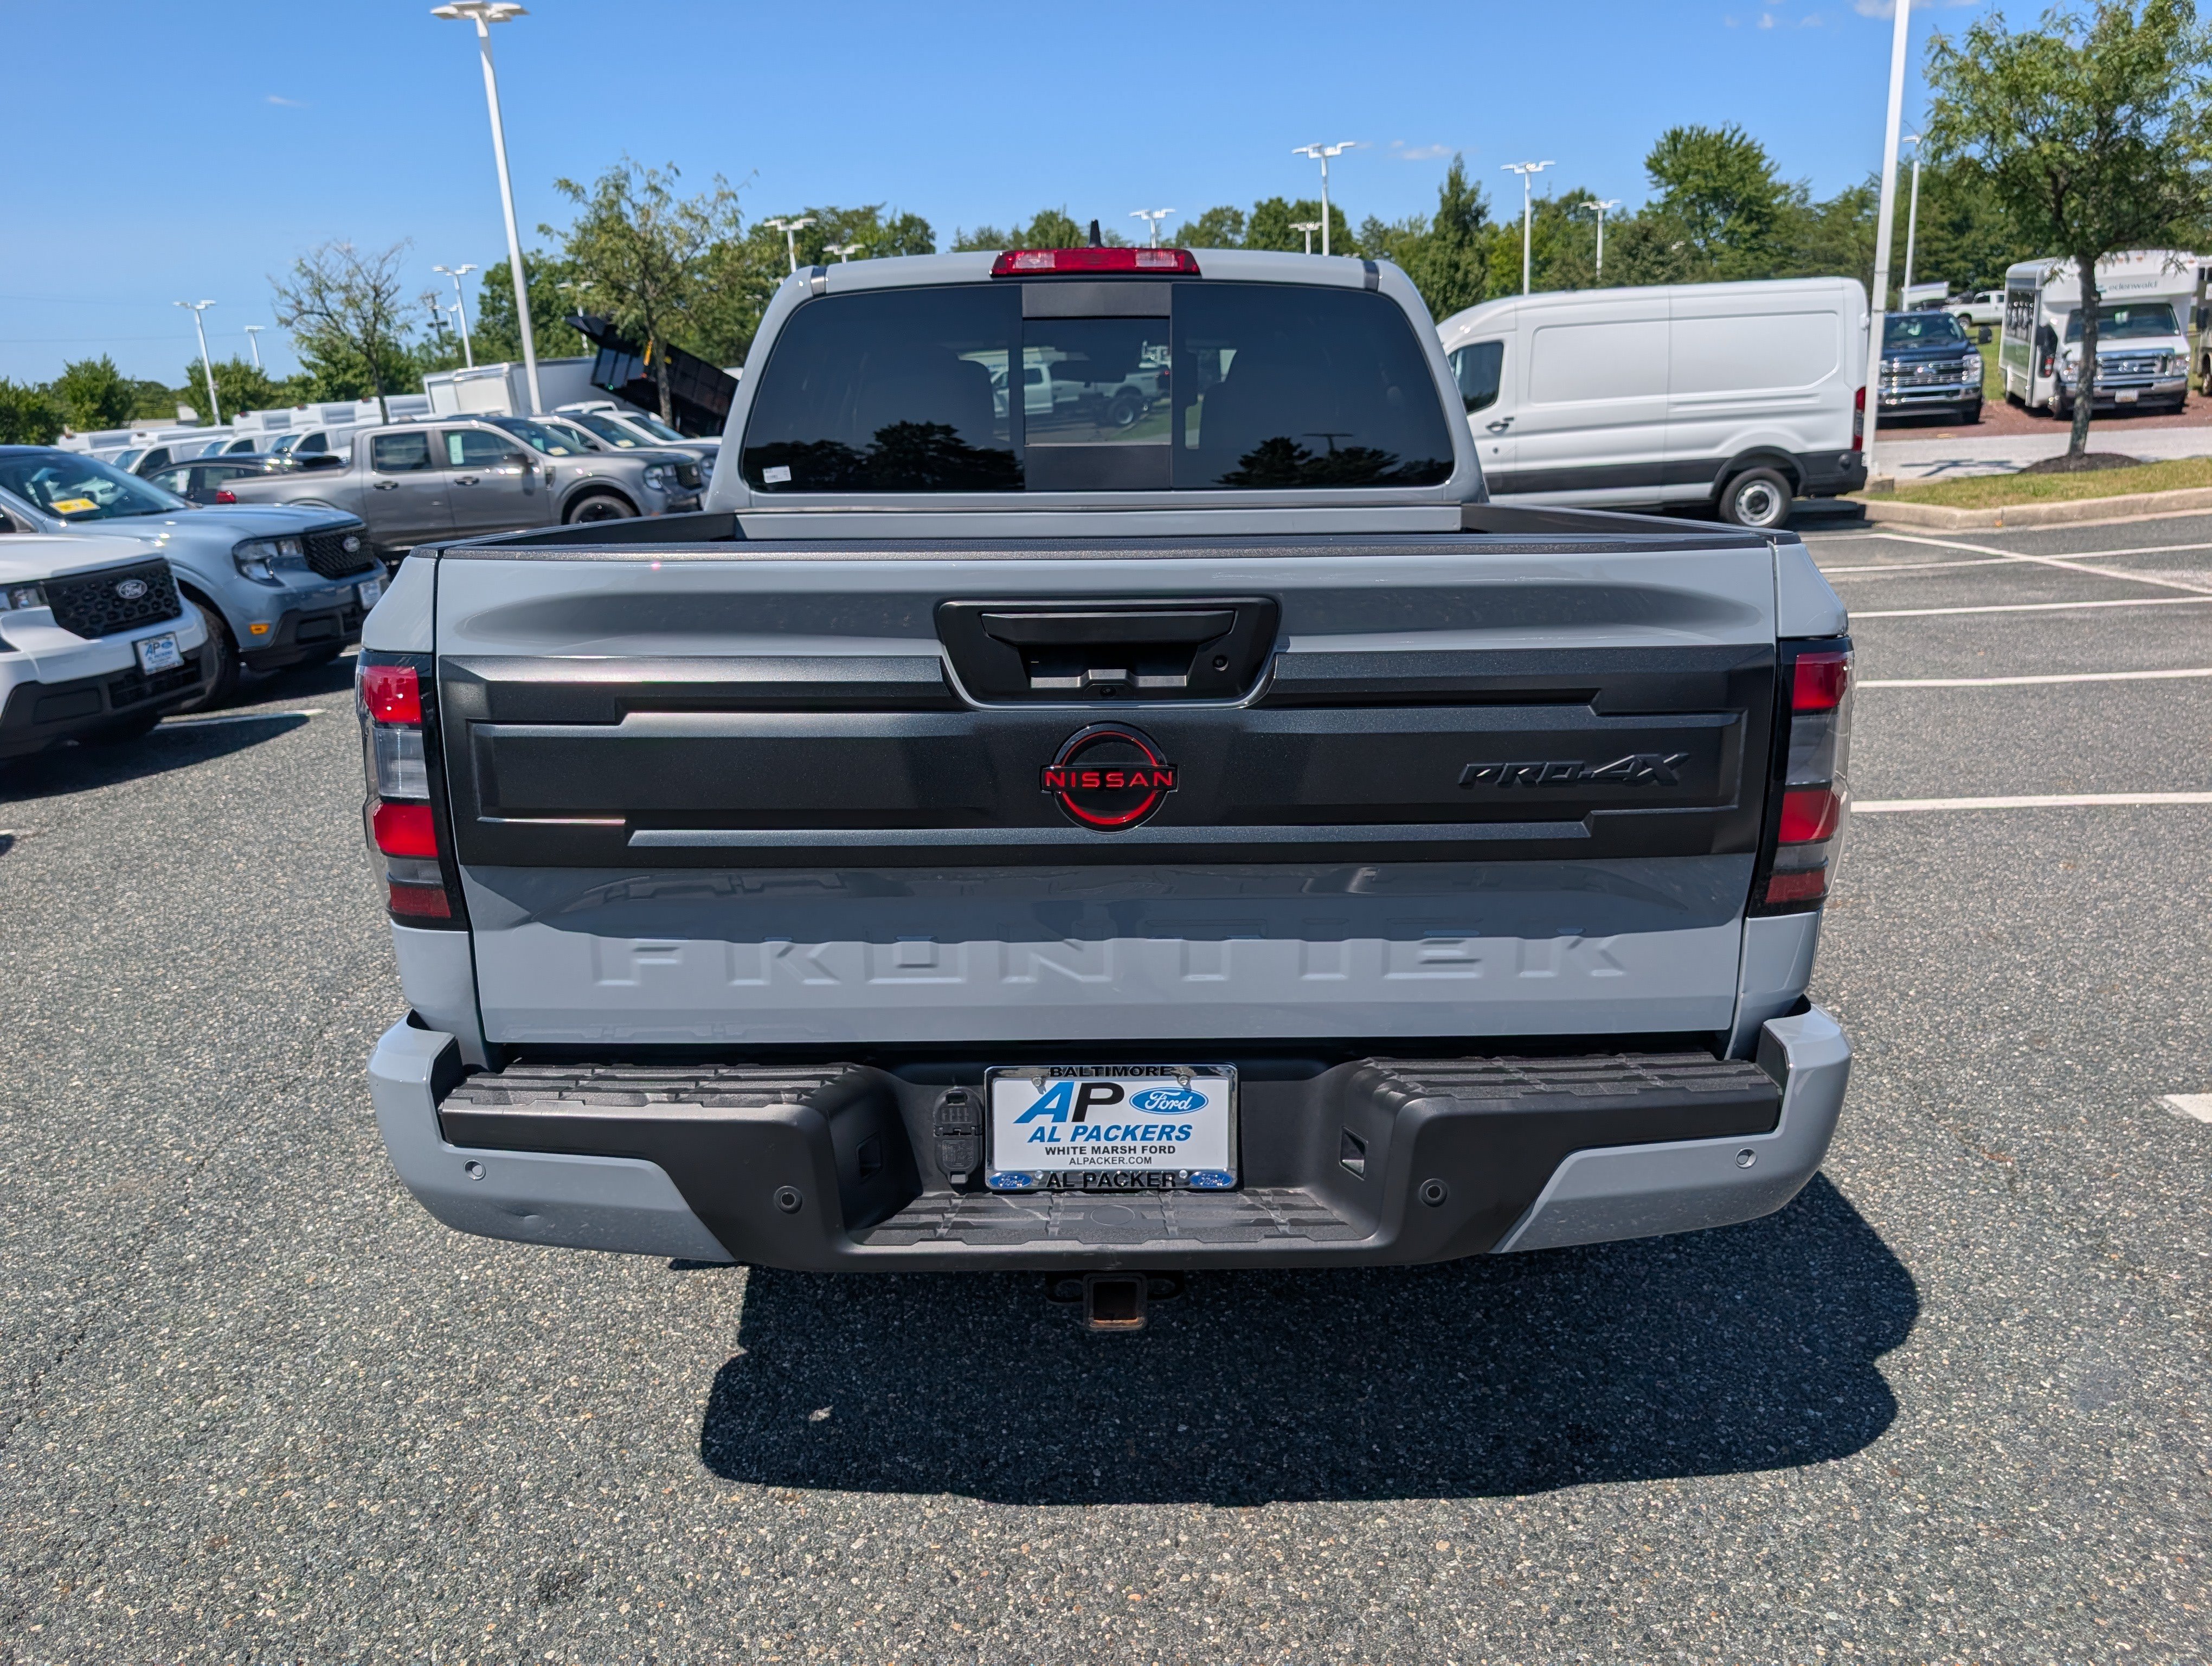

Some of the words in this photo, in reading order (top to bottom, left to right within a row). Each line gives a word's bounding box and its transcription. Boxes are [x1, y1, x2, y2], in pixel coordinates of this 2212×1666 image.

[2108, 280, 2158, 291] edenwald
[145, 642, 160, 657] AP
[1458, 753, 1690, 787] PRO-4X
[1045, 771, 1173, 787] NISSAN
[591, 930, 1626, 986] FRONTIER
[1050, 1066, 1173, 1077] BALTIMORE
[1013, 1081, 1125, 1124] AP
[1144, 1091, 1193, 1110] Ford
[1027, 1126, 1062, 1143] AL
[1070, 1124, 1193, 1142] PACKERS
[1045, 1146, 1087, 1155] WHITE
[1091, 1145, 1137, 1155] MARSH
[1141, 1145, 1176, 1154] FORD
[1069, 1156, 1152, 1165] ALPACKER.COM
[998, 1175, 1026, 1187] Ford
[1046, 1172, 1075, 1188] AL
[1083, 1171, 1176, 1187] PACKER
